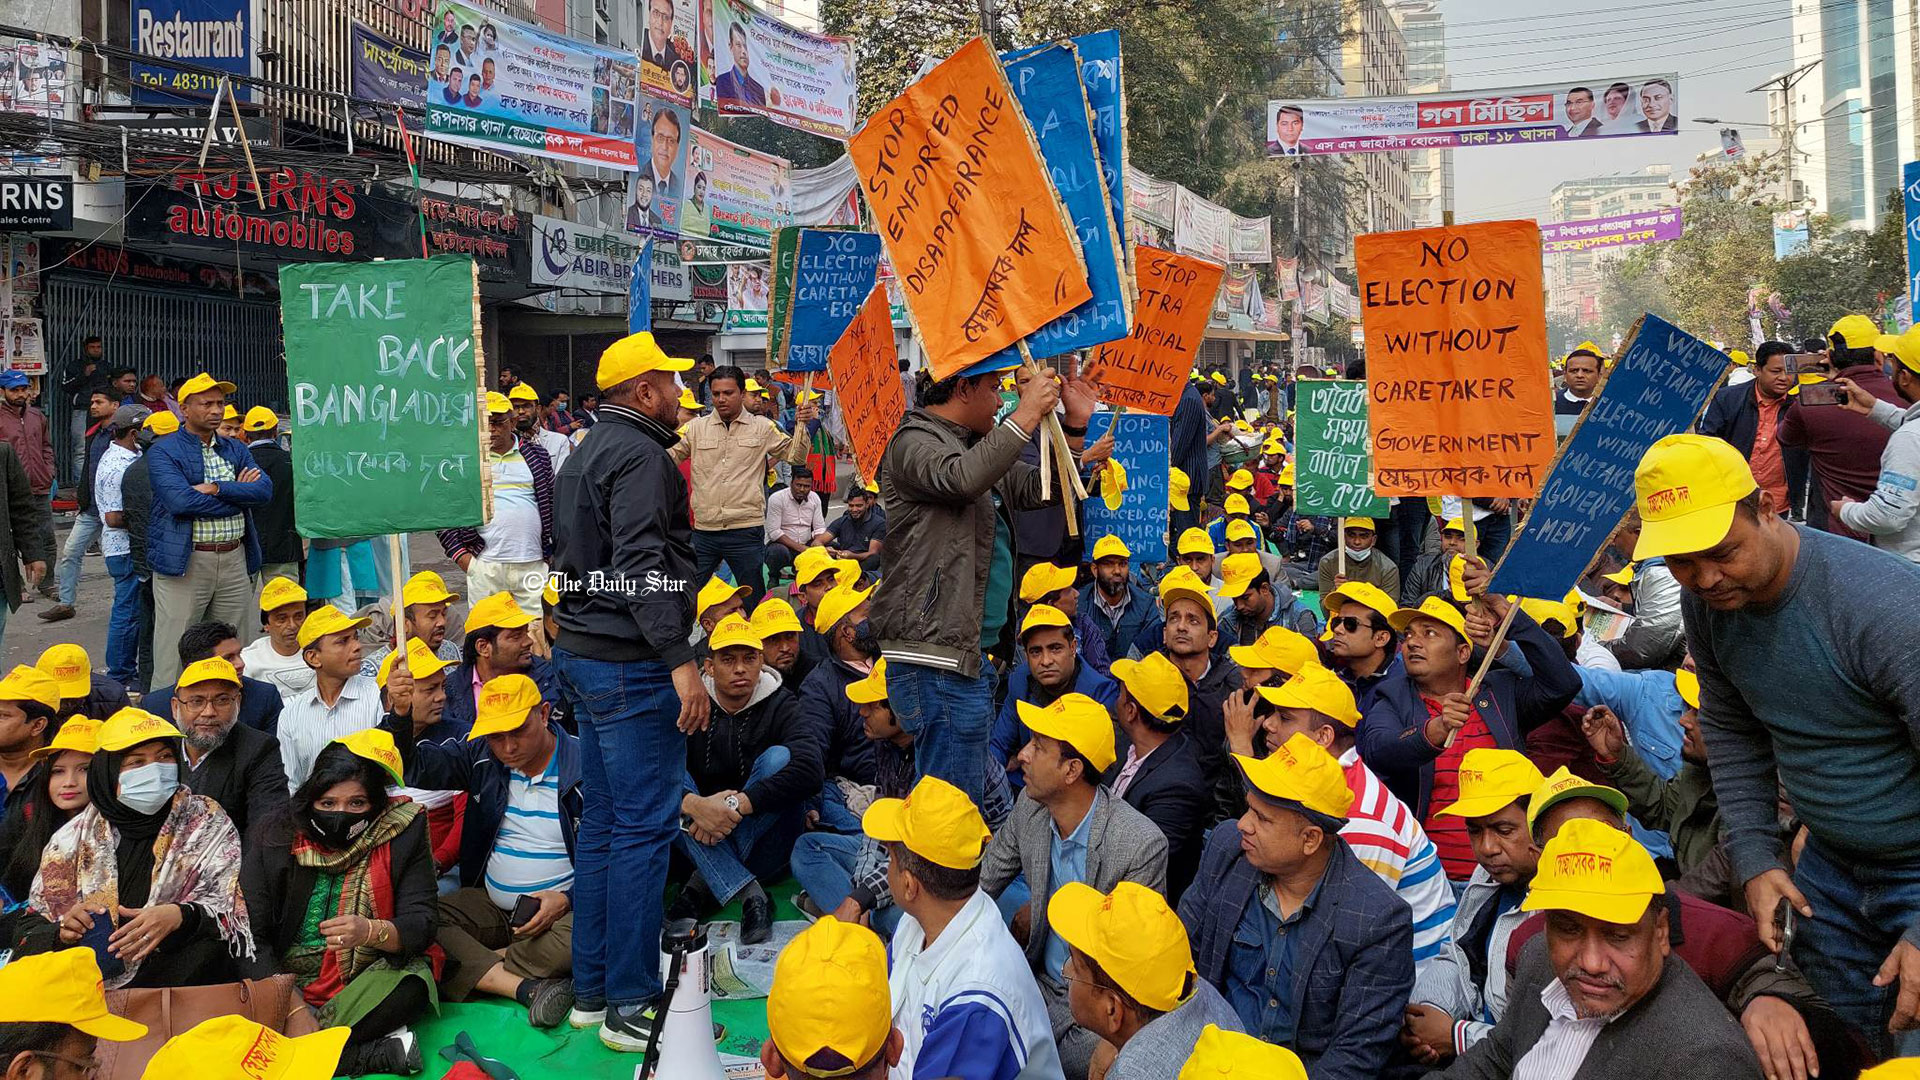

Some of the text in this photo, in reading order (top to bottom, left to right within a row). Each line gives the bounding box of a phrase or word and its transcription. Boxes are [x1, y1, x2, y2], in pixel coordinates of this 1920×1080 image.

[138, 9, 244, 58] Restaurant
[544, 104, 567, 120] কামনা
[568, 108, 589, 126] করছি
[1421, 97, 1551, 125] গণ মিছিল
[430, 108, 477, 133] রূপনগর
[480, 118, 506, 139] থানা
[506, 124, 565, 148] স্বেচ্ছাসেবক
[1315, 128, 1557, 151] এস এম জাহাঙ্গীর হোসেন ঢাকা-১৮ আসন
[869, 107, 906, 200] STOP
[886, 93, 960, 243] ENFORCED
[906, 86, 1004, 296] DISAPPEARANCE
[21, 216, 52, 224] Centre
[167, 204, 355, 255] automobiles
[1626, 229, 1656, 241] দল
[825, 233, 857, 252] NO
[1420, 236, 1469, 268] NO
[572, 254, 609, 277] ABIR
[613, 261, 684, 288] BRHERS
[801, 252, 879, 270] ELECTION
[1149, 258, 1198, 287] STOP
[300, 280, 406, 320] TAKE
[1366, 278, 1516, 308] ELECTION
[1384, 324, 1519, 355] WITHOUT
[375, 334, 470, 380] BACK
[1098, 344, 1178, 384] KILLING
[1373, 377, 1515, 404] CARETAKER
[1375, 428, 1541, 454] GOVERNMENT
[1493, 463, 1540, 490] দল
